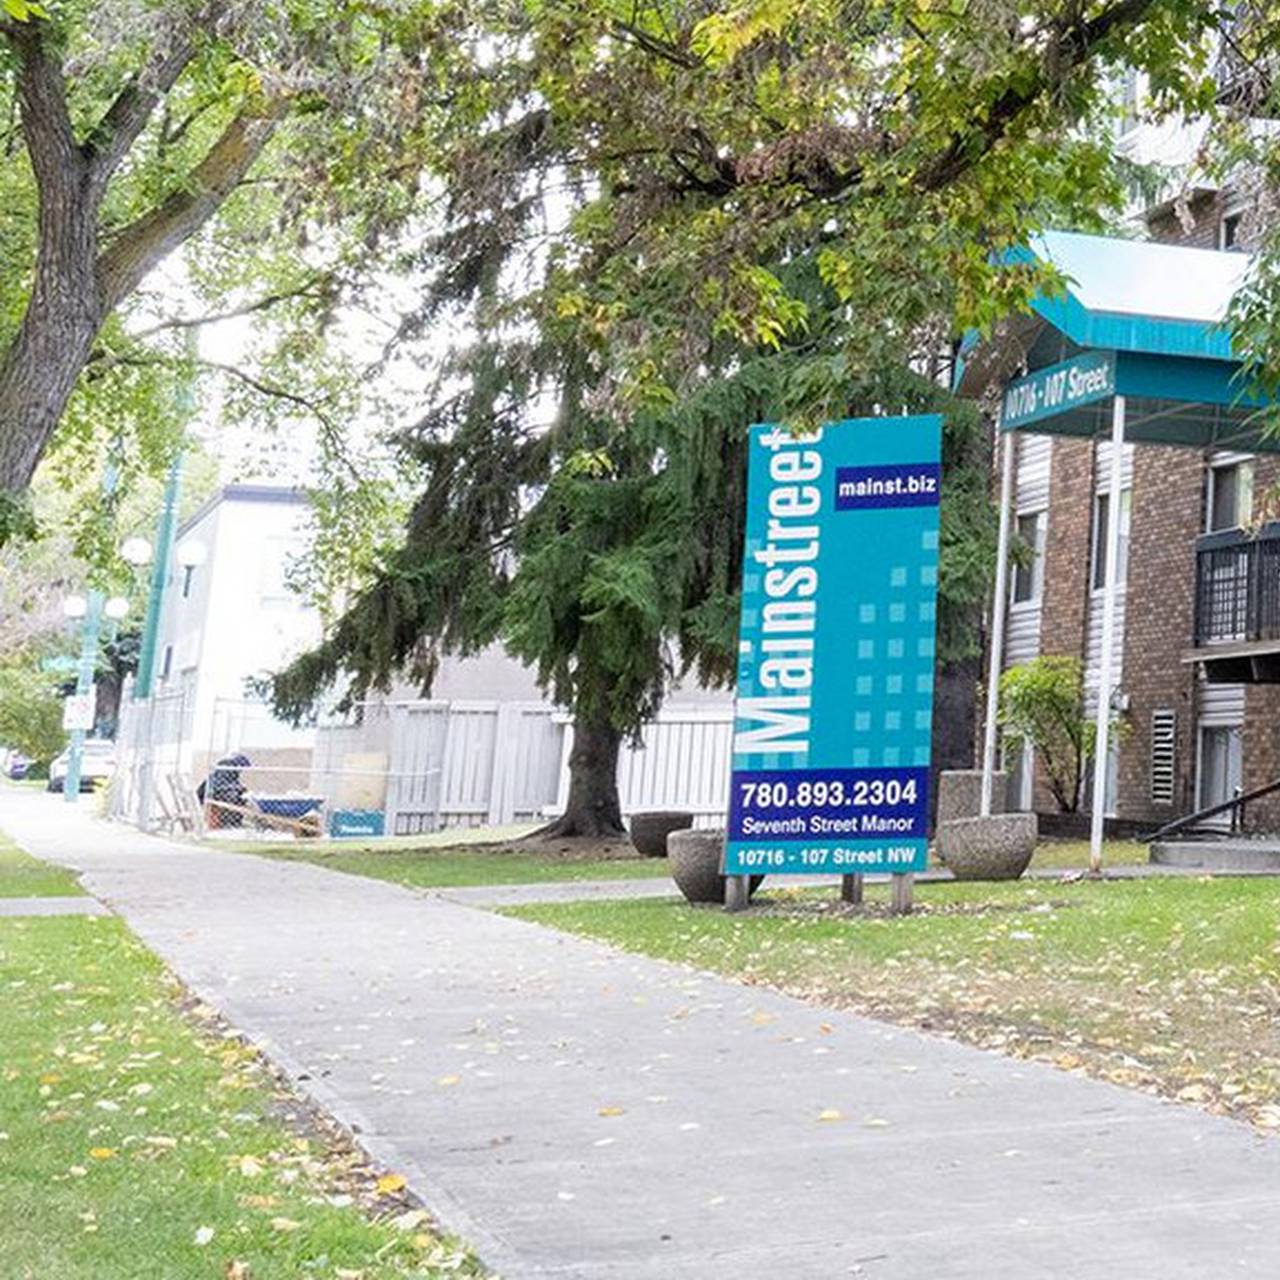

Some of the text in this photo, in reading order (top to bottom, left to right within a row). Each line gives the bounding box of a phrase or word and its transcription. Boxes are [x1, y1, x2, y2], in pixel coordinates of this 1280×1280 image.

[1044, 370, 1068, 407] 107
[1067, 364, 1109, 399] Street
[839, 475, 937, 496] mainst.biz
[734, 426, 823, 754] Mainstreet
[741, 779, 917, 808] 780.893.2304
[742, 814, 915, 834] Seventh Street Manor
[737, 849, 785, 866] 10716
[801, 848, 829, 864] 107
[832, 846, 883, 864] Street
[887, 846, 917, 863] NW
